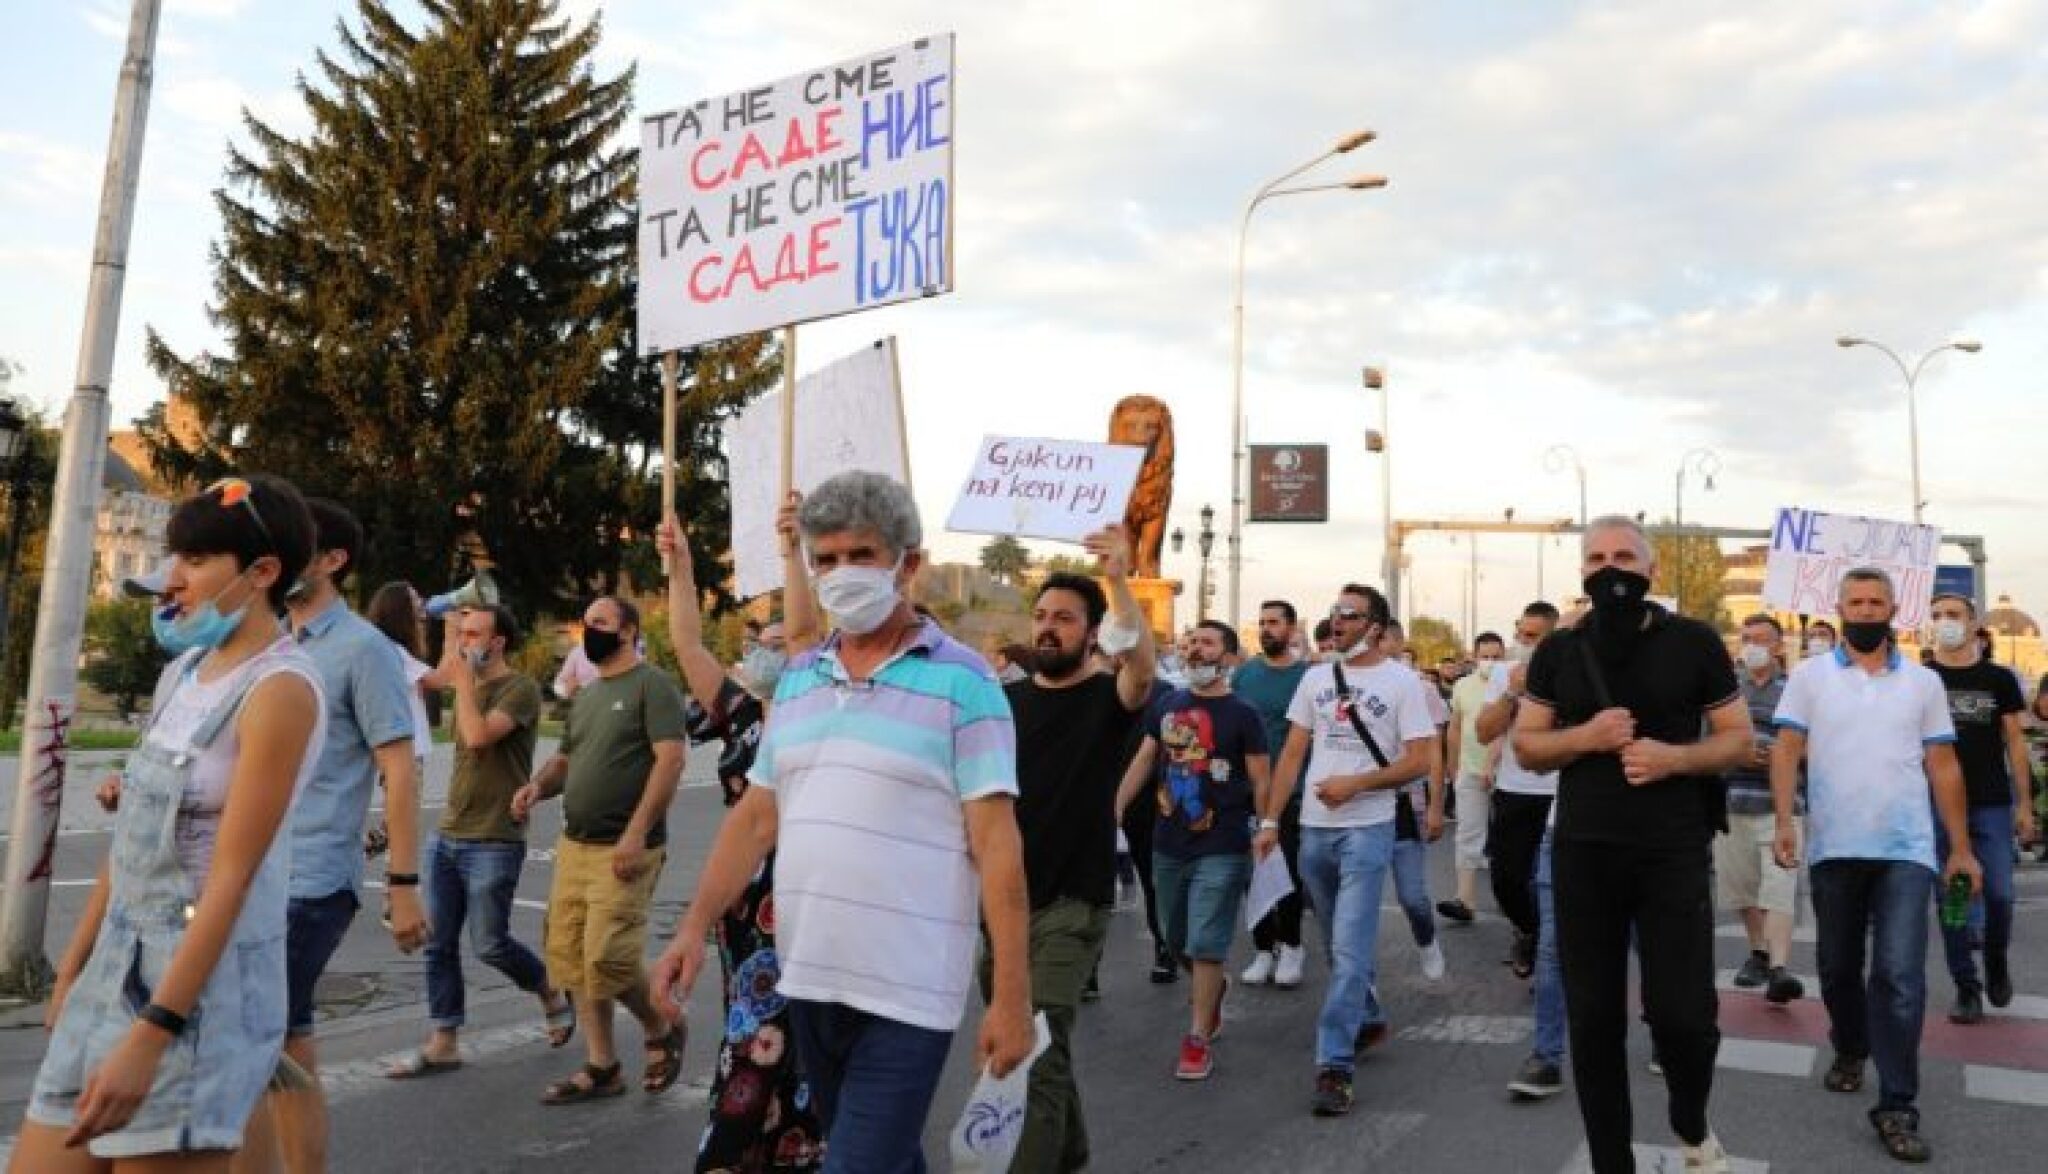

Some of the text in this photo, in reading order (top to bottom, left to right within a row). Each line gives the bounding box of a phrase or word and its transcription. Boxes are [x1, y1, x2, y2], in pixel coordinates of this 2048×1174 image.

[644, 56, 896, 148] ТА НЕ СМЕ
[690, 73, 950, 192] САДЕ НИЕ
[646, 153, 866, 259] ТА НЕ СМЕ
[688, 177, 945, 305] САДЕ ТУКА
[966, 477, 1000, 498] na
[1008, 474, 1064, 503] keni
[988, 441, 1094, 476] Gjakun
[1773, 507, 1830, 555] NE
